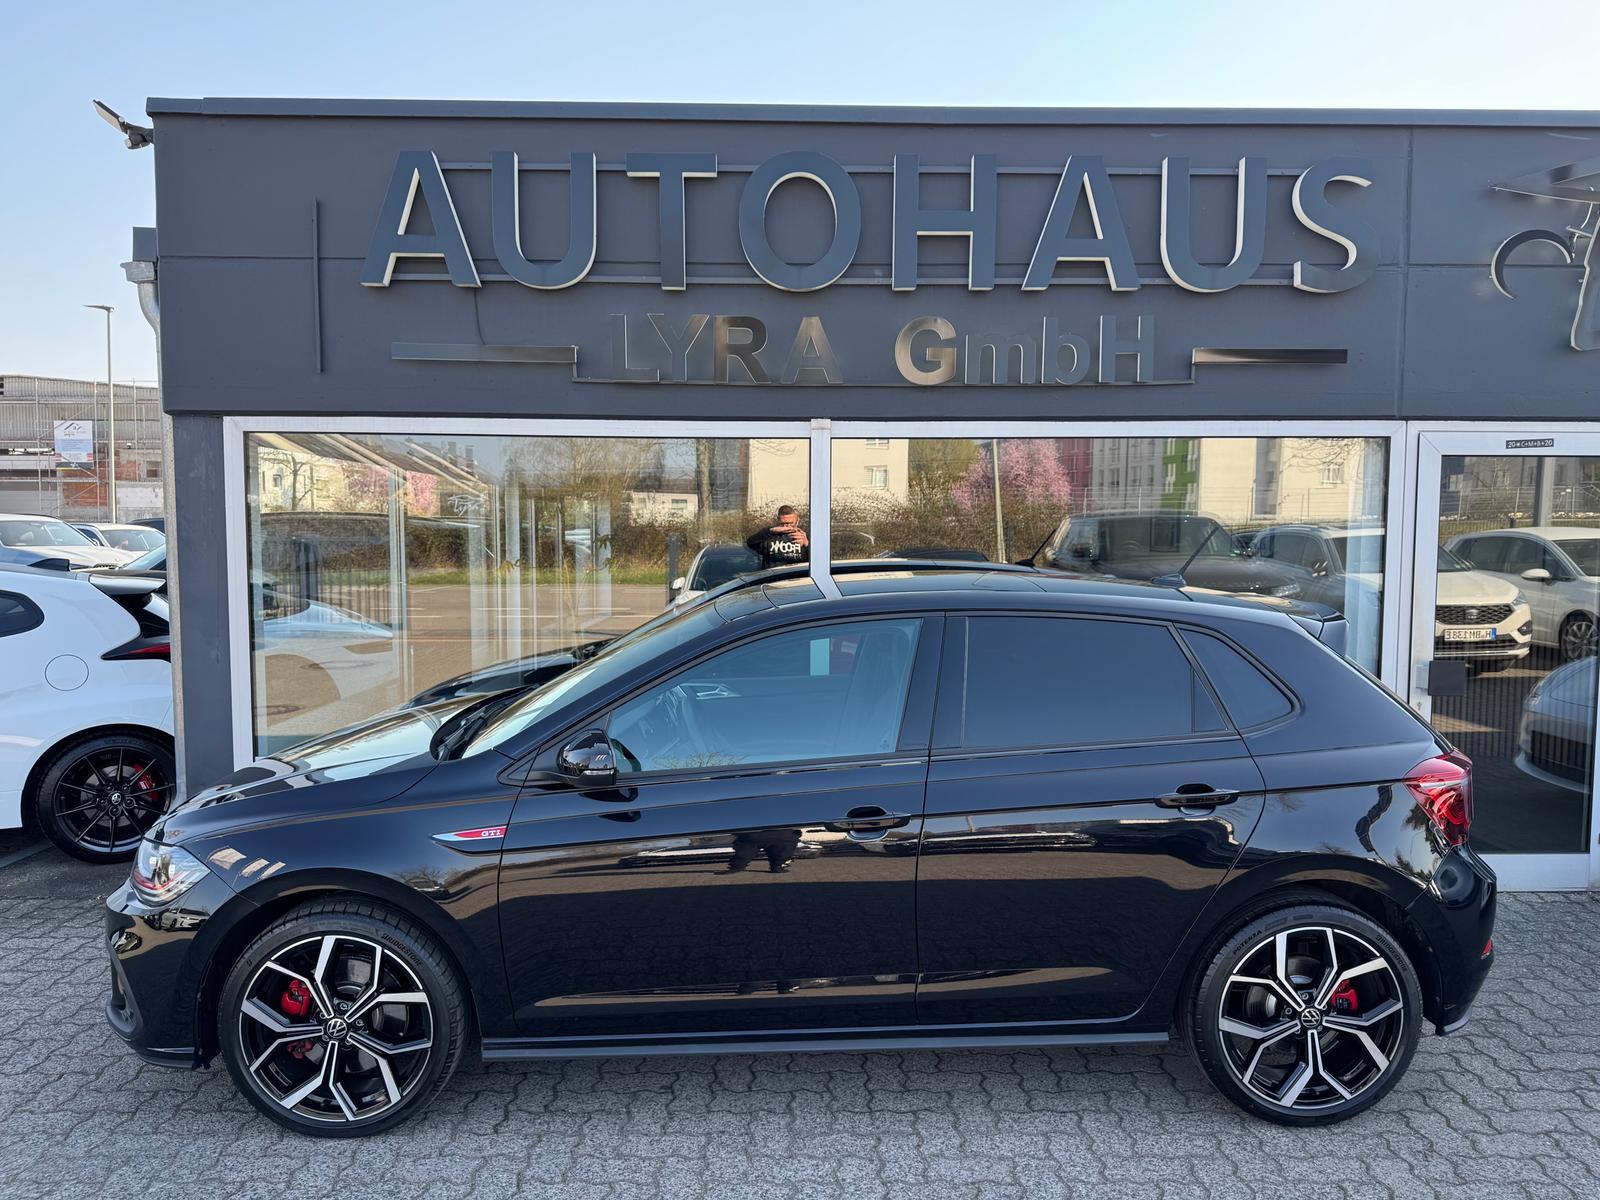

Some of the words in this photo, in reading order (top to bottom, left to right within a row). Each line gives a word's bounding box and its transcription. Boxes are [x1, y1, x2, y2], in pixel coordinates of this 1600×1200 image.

[360, 150, 1379, 293] AUTOHAUS
[609, 313, 844, 384] LYRA
[894, 314, 1155, 386] GmbH
[481, 829, 501, 837] GTI
[381, 932, 423, 967] BRIDGESTONE
